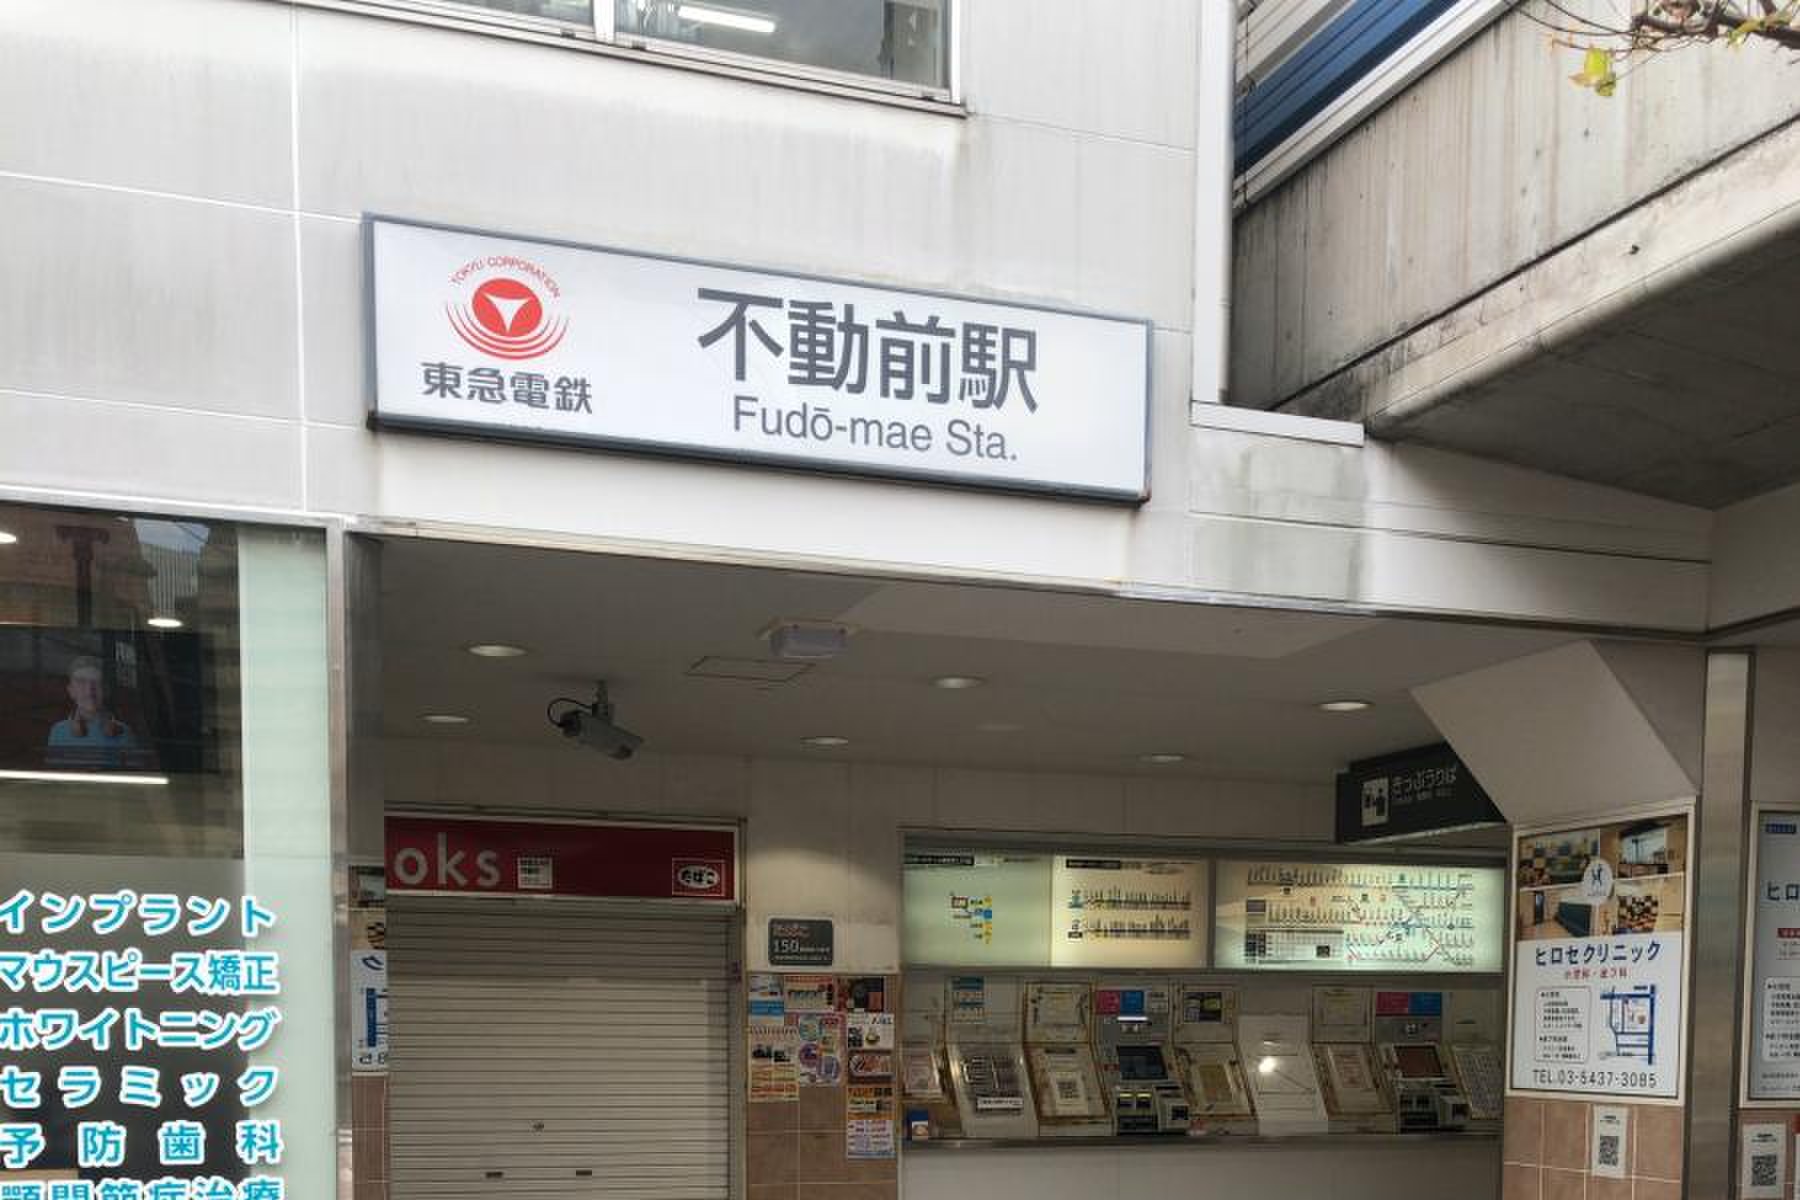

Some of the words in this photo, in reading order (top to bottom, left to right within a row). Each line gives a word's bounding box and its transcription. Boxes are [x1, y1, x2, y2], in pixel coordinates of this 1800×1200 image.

[449, 258, 483, 285] TOKYU
[487, 255, 560, 299] CORPORATION
[696, 286, 1039, 414] 不動前駅
[420, 360, 593, 415] 東急電鉄
[733, 396, 933, 452] Fudō-mae
[945, 418, 1018, 461] Sta.
[0, 890, 276, 936] インプラント
[0, 949, 281, 994] マウスピース矯正
[1535, 940, 1661, 967] ヒロセクリニック
[0, 1006, 282, 1050] ホワイトニング
[0, 1066, 278, 1107] セラミック
[0, 1121, 283, 1168] 予防歯科
